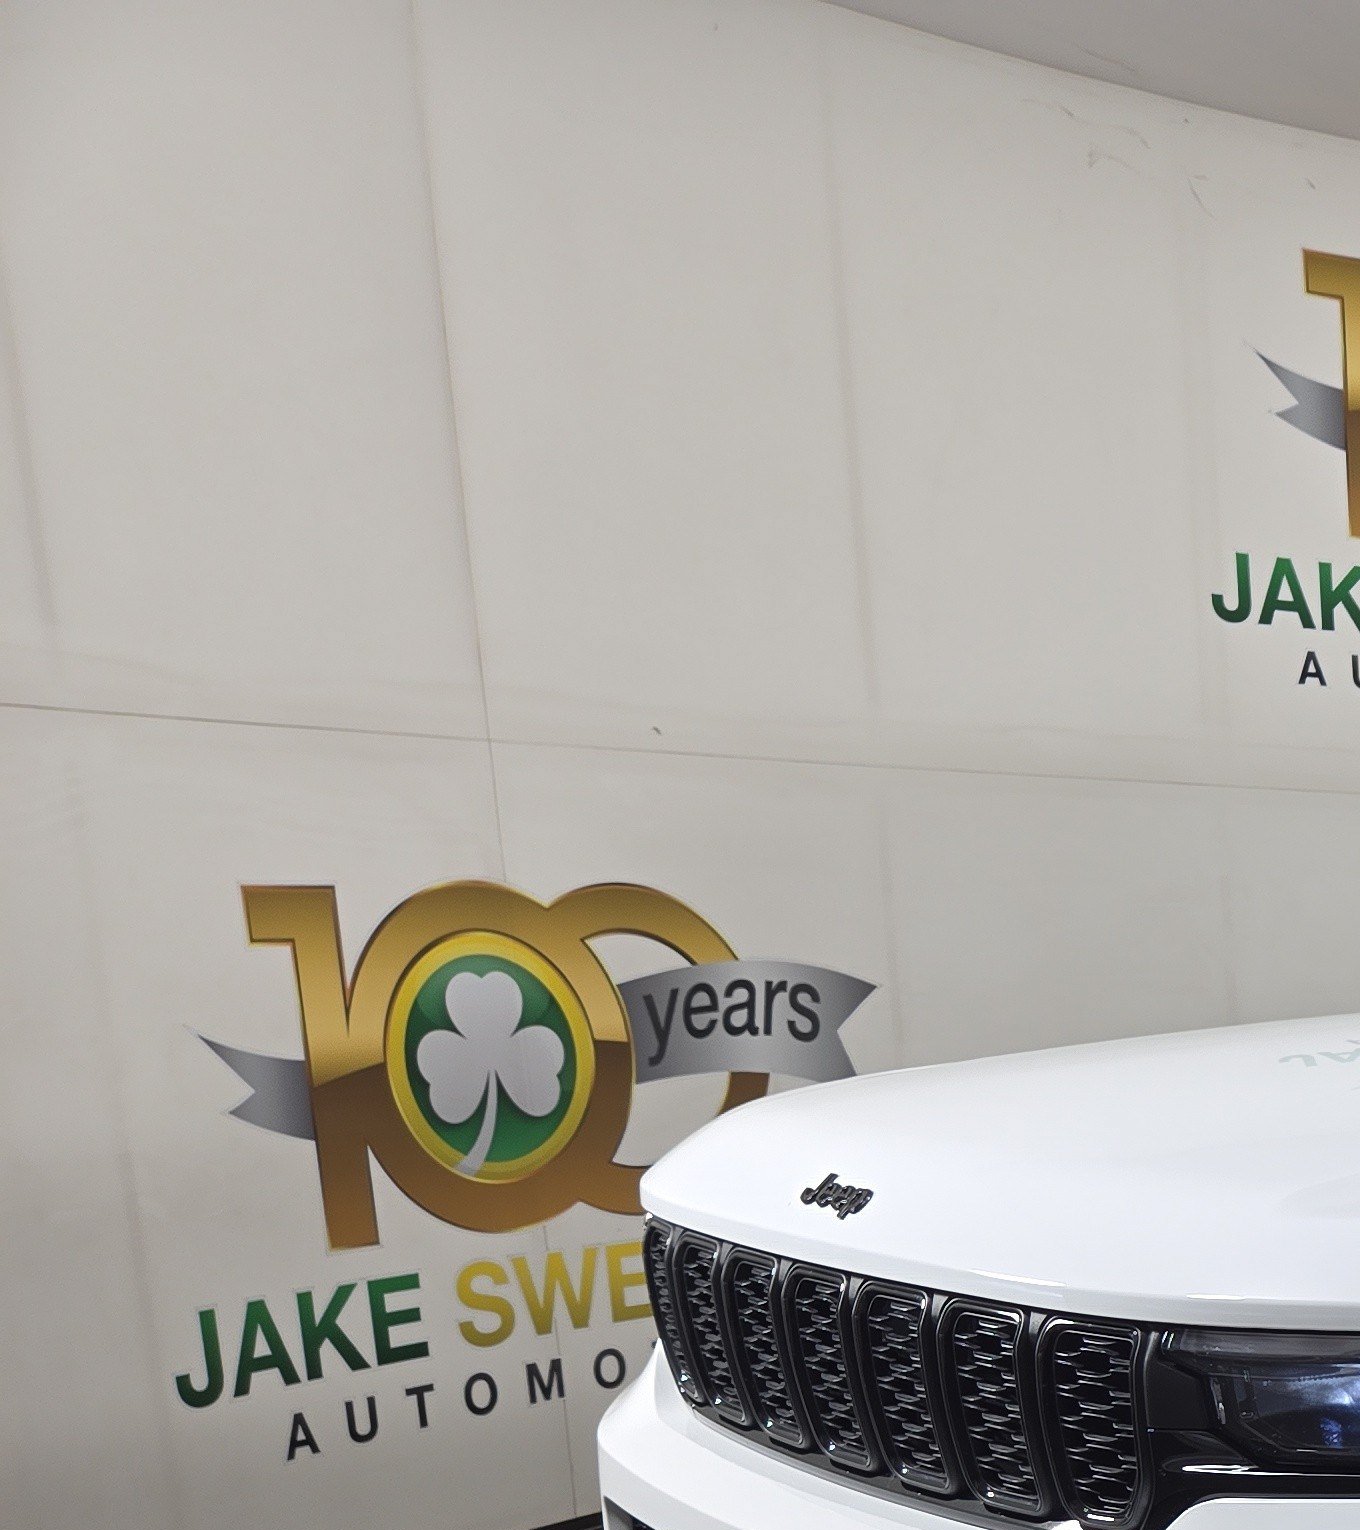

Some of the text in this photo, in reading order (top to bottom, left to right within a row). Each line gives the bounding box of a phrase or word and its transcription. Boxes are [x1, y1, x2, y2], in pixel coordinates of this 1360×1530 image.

[643, 978, 822, 1066] years
[800, 1172, 874, 1221] Jeep
[175, 1272, 430, 1409] JAKE
[286, 1340, 656, 1461] AUTOMO
